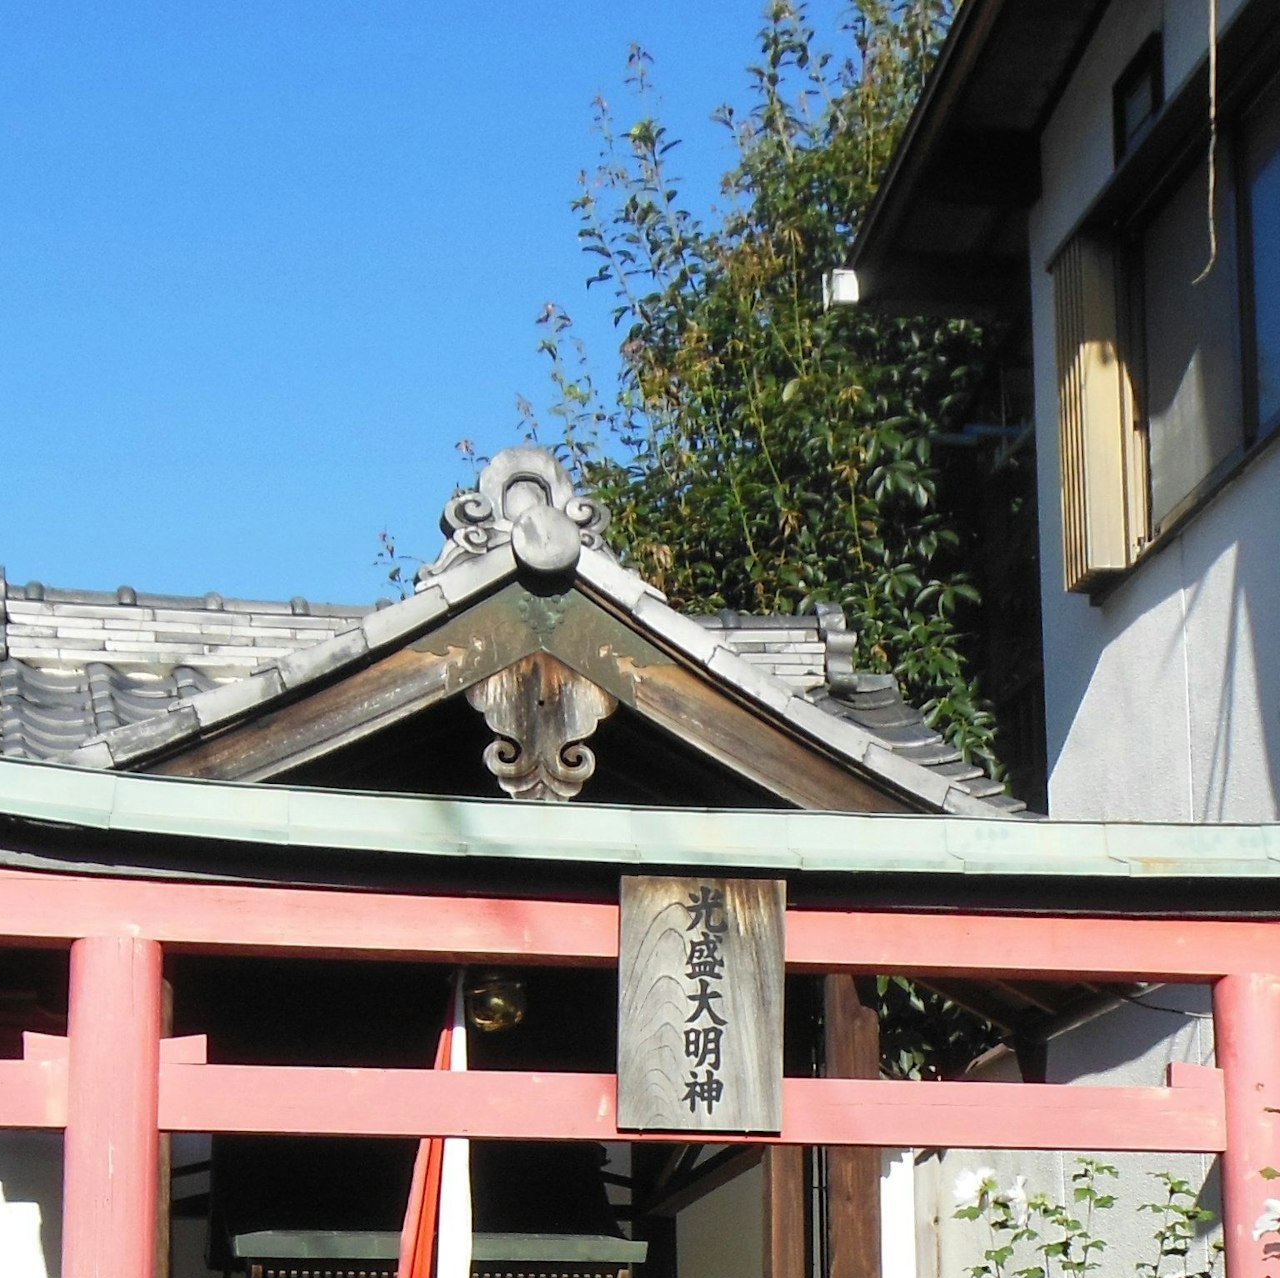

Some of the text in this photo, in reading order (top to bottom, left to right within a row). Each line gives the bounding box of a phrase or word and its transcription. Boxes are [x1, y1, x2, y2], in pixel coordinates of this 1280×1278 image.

[681, 886, 729, 1116] 光盛大明神
